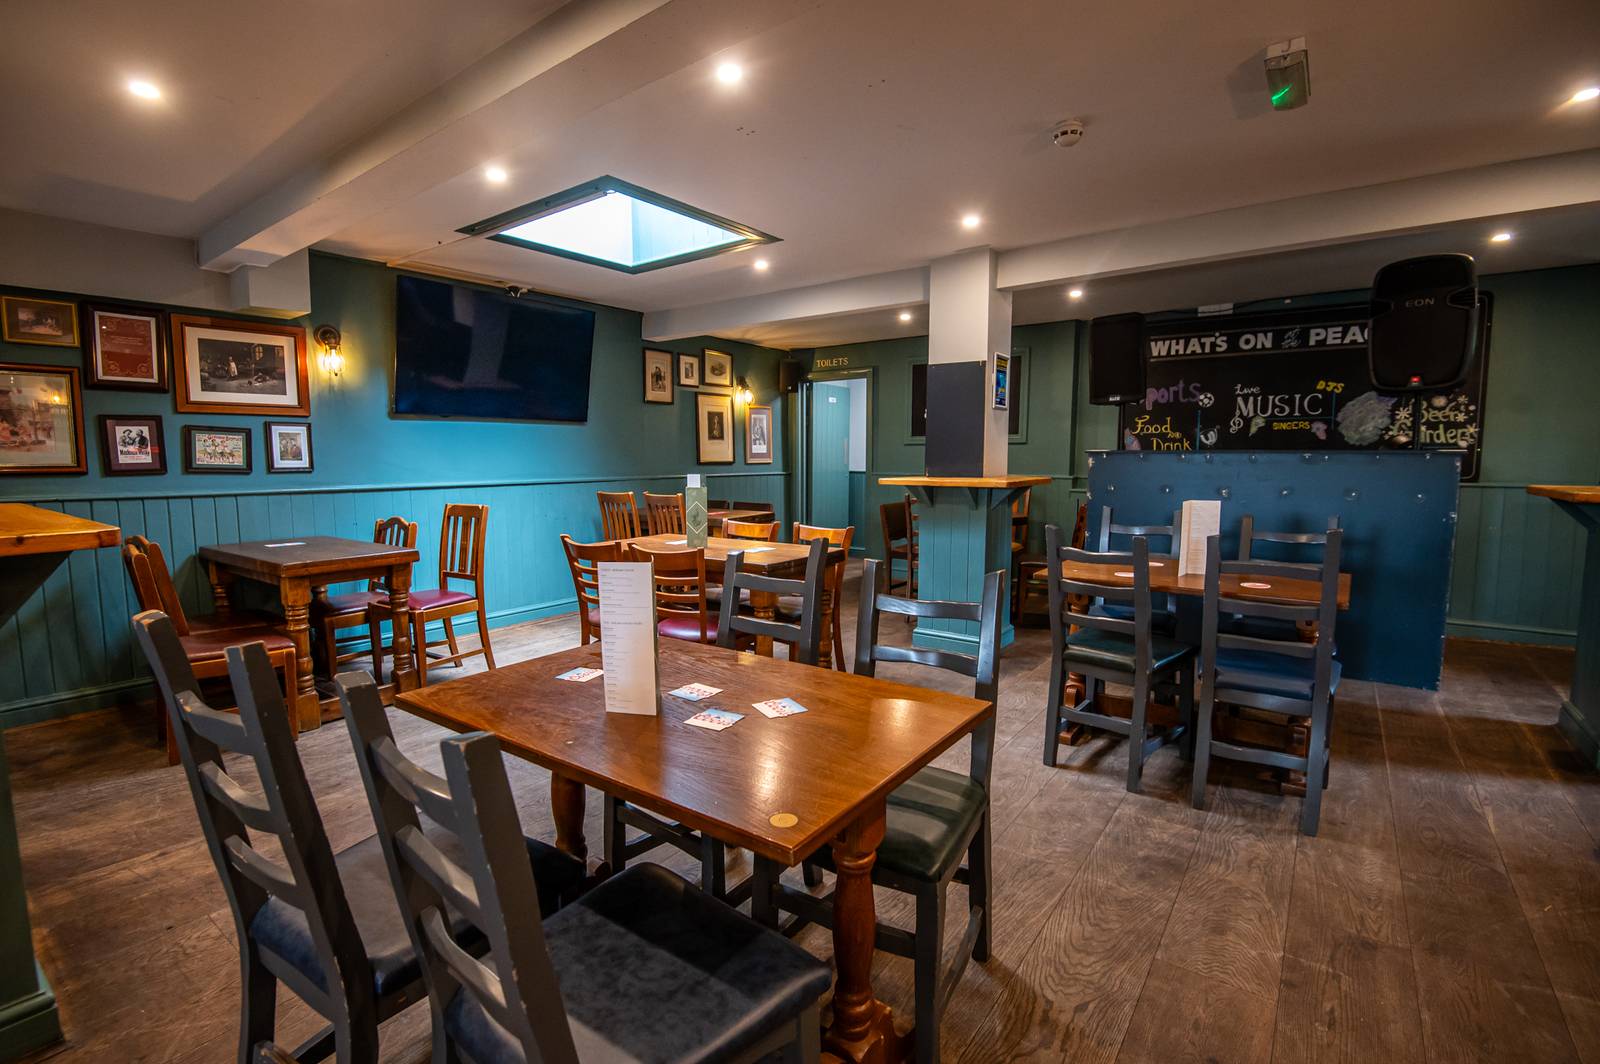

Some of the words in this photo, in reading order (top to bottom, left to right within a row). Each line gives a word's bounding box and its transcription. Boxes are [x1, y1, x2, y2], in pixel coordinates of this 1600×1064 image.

[1405, 297, 1435, 308] EON
[1150, 332, 1228, 356] WHAT'S
[1239, 332, 1272, 350] ON
[816, 357, 849, 368] TOILETS
[1143, 379, 1201, 411] ports
[1236, 393, 1323, 418] MUSIC
[1131, 415, 1171, 435] Food
[1272, 421, 1311, 430] SINGERS
[1150, 437, 1193, 451] Drink
